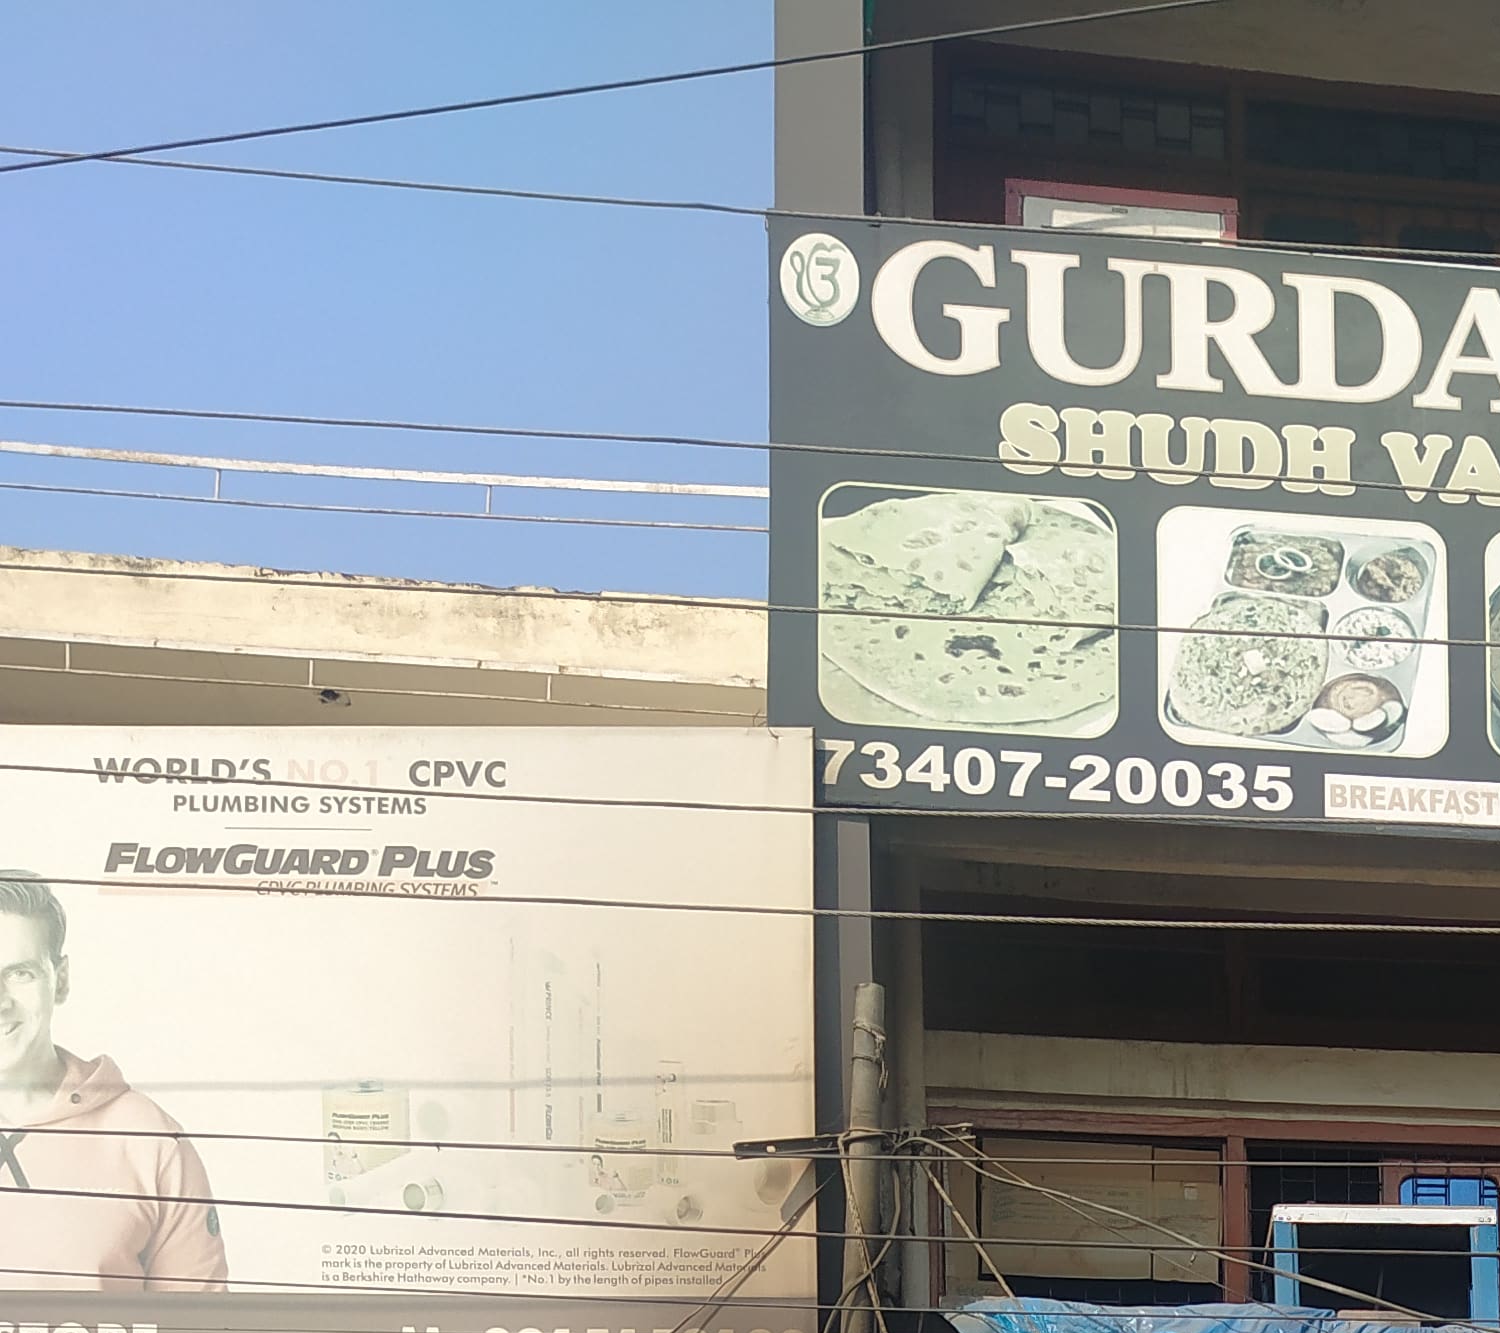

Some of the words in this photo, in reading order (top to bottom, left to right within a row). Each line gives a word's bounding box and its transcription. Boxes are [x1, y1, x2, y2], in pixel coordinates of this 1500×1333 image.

[999, 403, 1356, 497] SHUDH
[93, 757, 272, 784] WORLD'S
[287, 759, 378, 786] NO.1
[408, 760, 507, 788] CPVC
[817, 739, 1293, 813] 73407-20035
[173, 794, 310, 814] PLUMBING
[319, 796, 427, 815] SYSTEMS
[1329, 783, 1499, 819] BREAKFAST
[378, 845, 496, 879] PLUS
[400, 882, 479, 897] SYSTEMS
[336, 1245, 366, 1255] 2020
[370, 1245, 414, 1256] Lubrizol
[418, 1246, 474, 1257] Advanced
[478, 1247, 534, 1258] Materials,
[566, 1248, 579, 1258] all
[583, 1248, 614, 1260] rights
[618, 1249, 669, 1259] reserved.
[322, 1259, 350, 1269] mark
[353, 1259, 361, 1269] is
[365, 1260, 382, 1270] the
[385, 1260, 432, 1272] property
[435, 1260, 446, 1270] of
[449, 1260, 493, 1271] Lubrizol
[495, 1261, 550, 1272] Advanced
[612, 1262, 655, 1273] Lubrizol
[658, 1262, 712, 1273] Advanced
[322, 1272, 330, 1282] is
[343, 1272, 395, 1283] Berkshire
[398, 1273, 455, 1285] Hathaway
[457, 1275, 511, 1286] company.
[558, 1275, 570, 1286] by
[573, 1275, 591, 1286] the
[593, 1275, 629, 1287] length
[631, 1275, 642, 1286] of
[644, 1275, 673, 1287] pipes
[675, 1276, 723, 1286] installed
